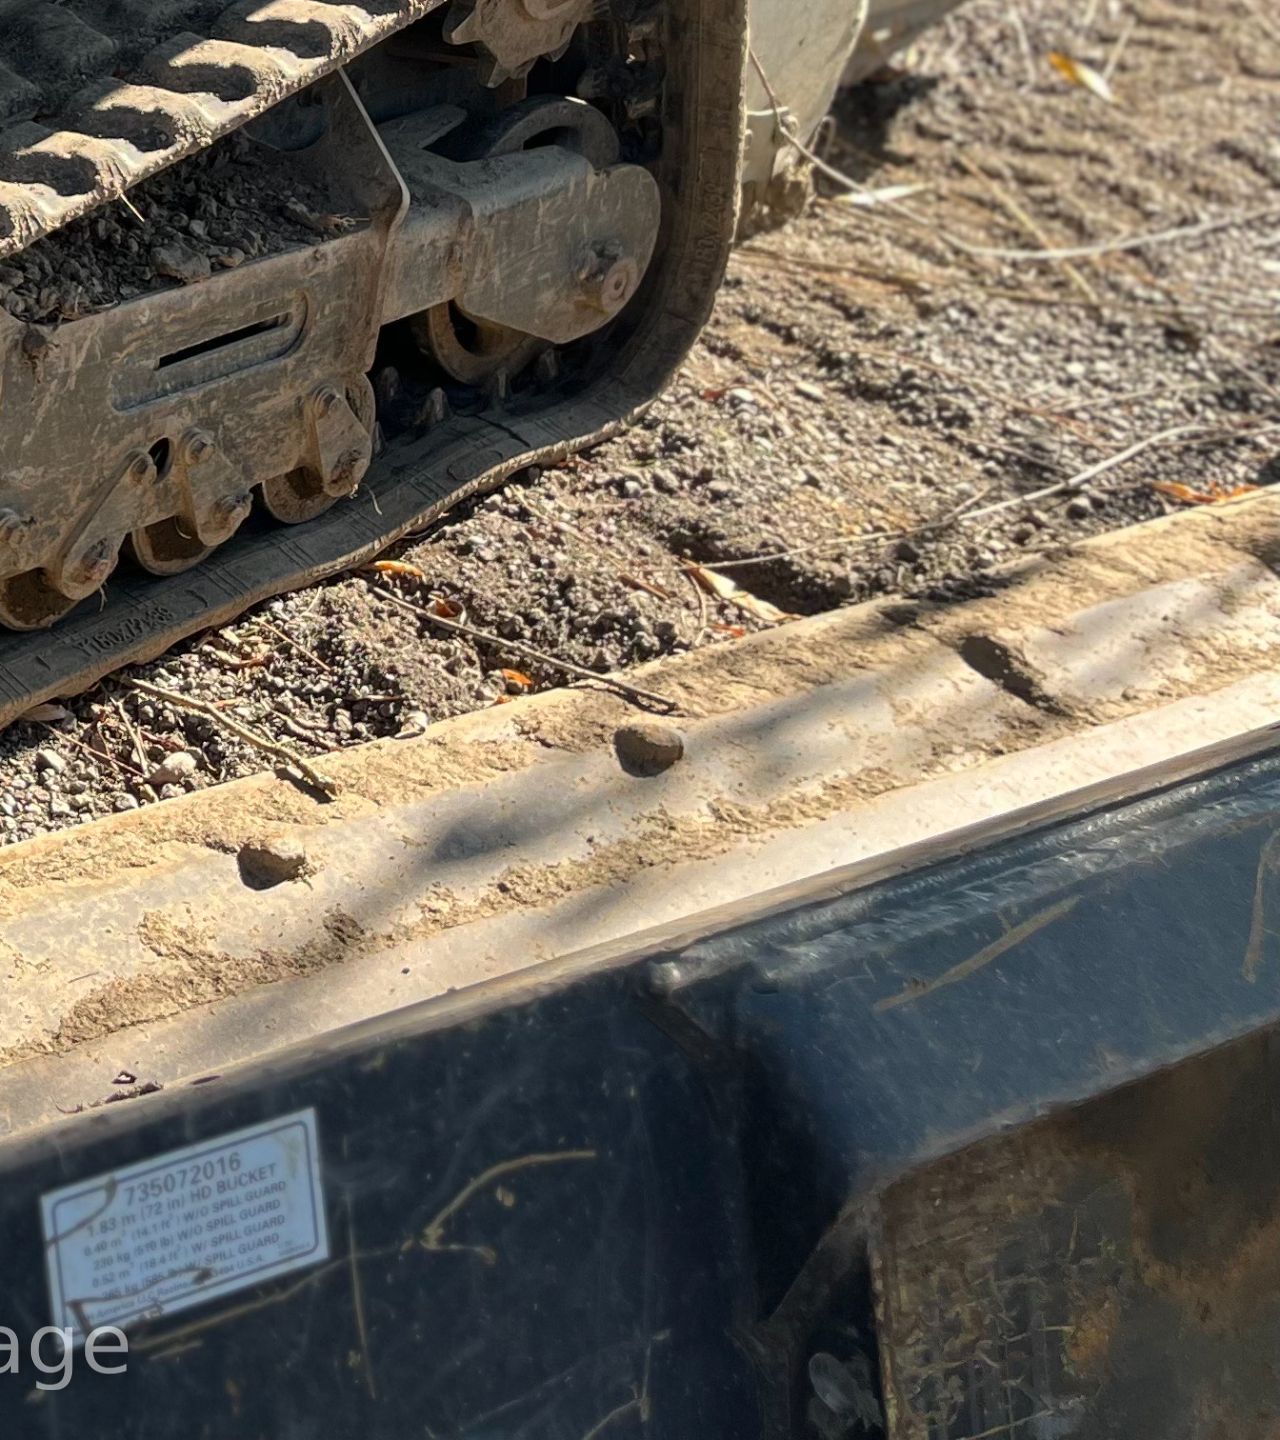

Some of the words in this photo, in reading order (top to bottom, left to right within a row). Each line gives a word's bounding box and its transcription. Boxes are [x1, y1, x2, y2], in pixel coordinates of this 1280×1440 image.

[124, 1151, 241, 1206] 735072016
[87, 1217, 116, 1237] 1.83
[122, 1213, 135, 1225] m
[140, 1201, 161, 1220] (72
[168, 1194, 184, 1211] in)
[190, 1186, 211, 1202] HD
[216, 1163, 276, 1194] BUCKET
[178, 1225, 202, 1241] W/O
[206, 1213, 235, 1231] SPILL
[240, 1198, 280, 1220] GUARD
[184, 1207, 207, 1222] W/O
[212, 1195, 241, 1212] SPILL
[245, 1180, 285, 1202] GUARD
[204, 1247, 235, 1265] SPILL
[238, 1232, 278, 1254] GUARD
[210, 1229, 240, 1248] SPILL
[243, 1214, 284, 1236] GUARD
